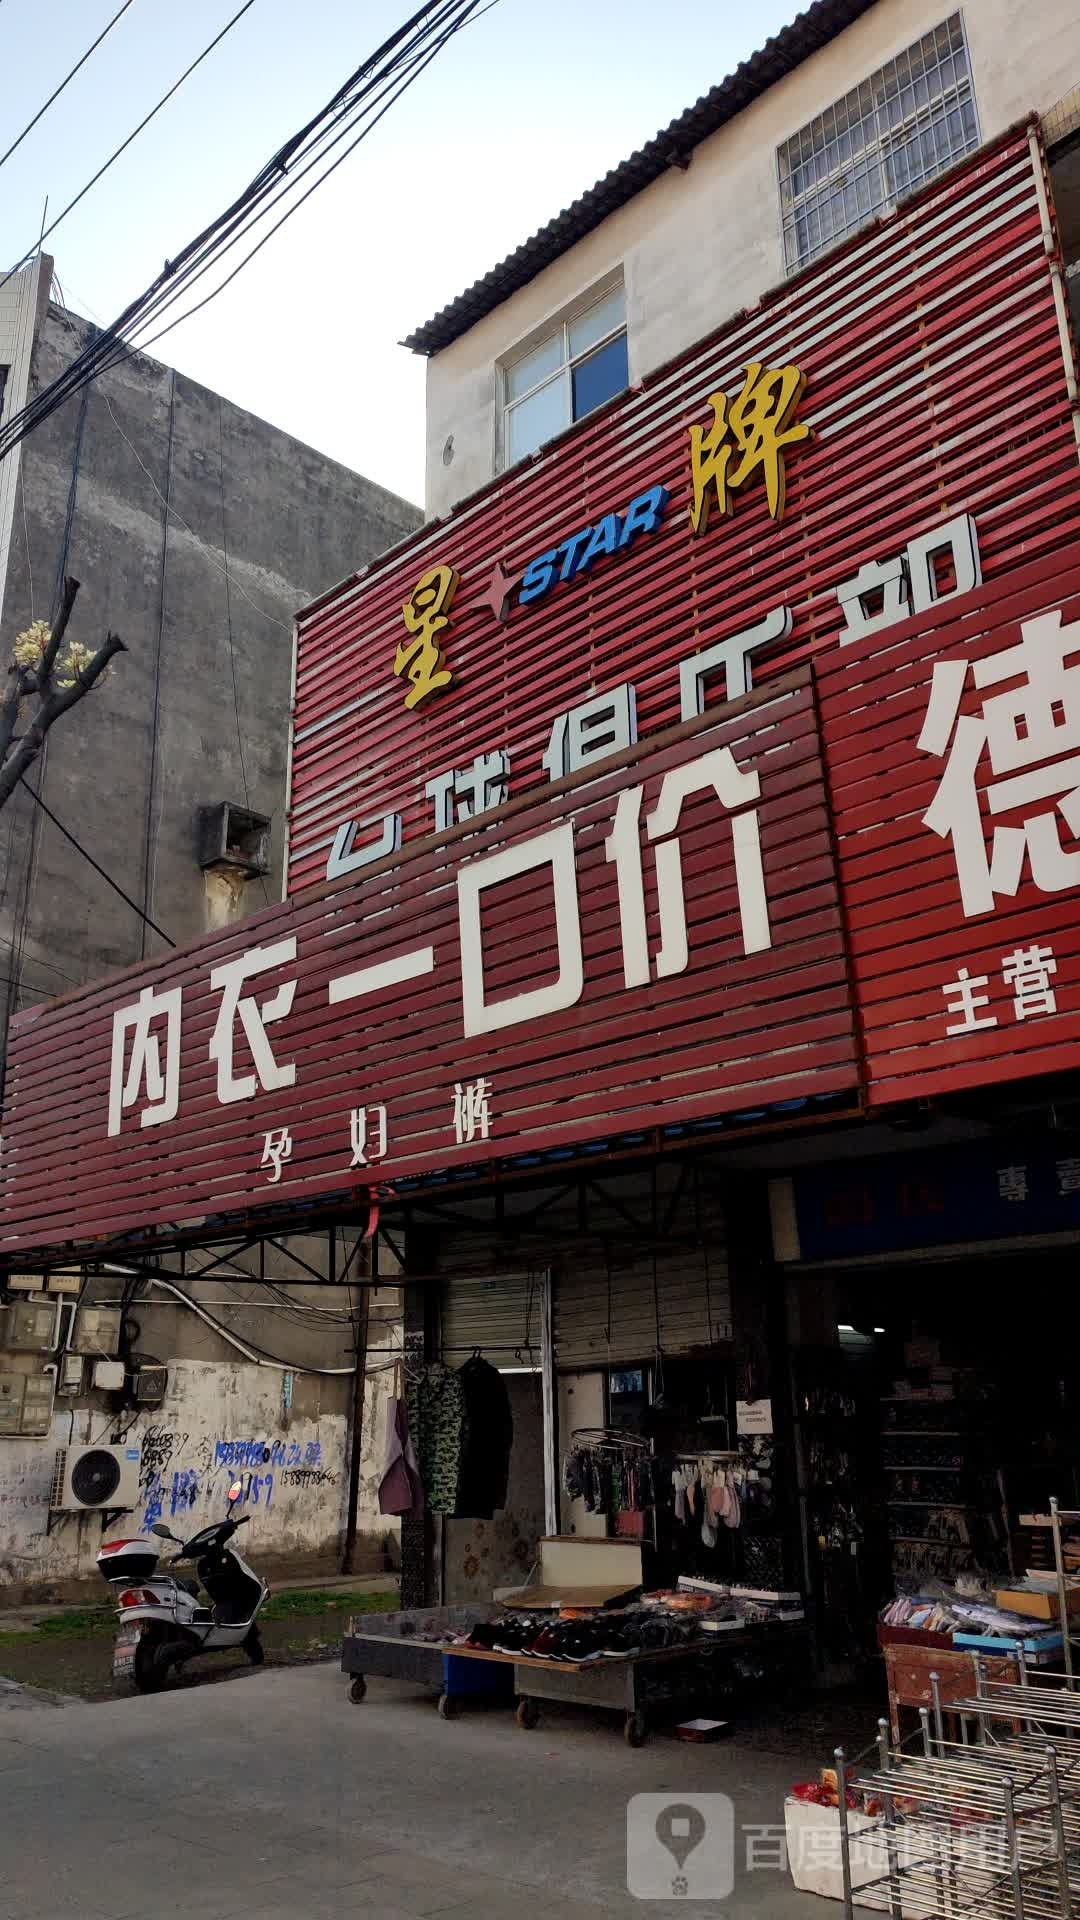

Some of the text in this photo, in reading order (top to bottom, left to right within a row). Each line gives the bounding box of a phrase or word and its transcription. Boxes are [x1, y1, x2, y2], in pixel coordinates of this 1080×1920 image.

[392, 361, 815, 712] 星 STAR 牌
[916, 609, 1080, 918] 德
[107, 746, 772, 1138] 内衣一口价
[941, 944, 1058, 1037] 主营
[259, 1077, 494, 1184] 孕妇裤
